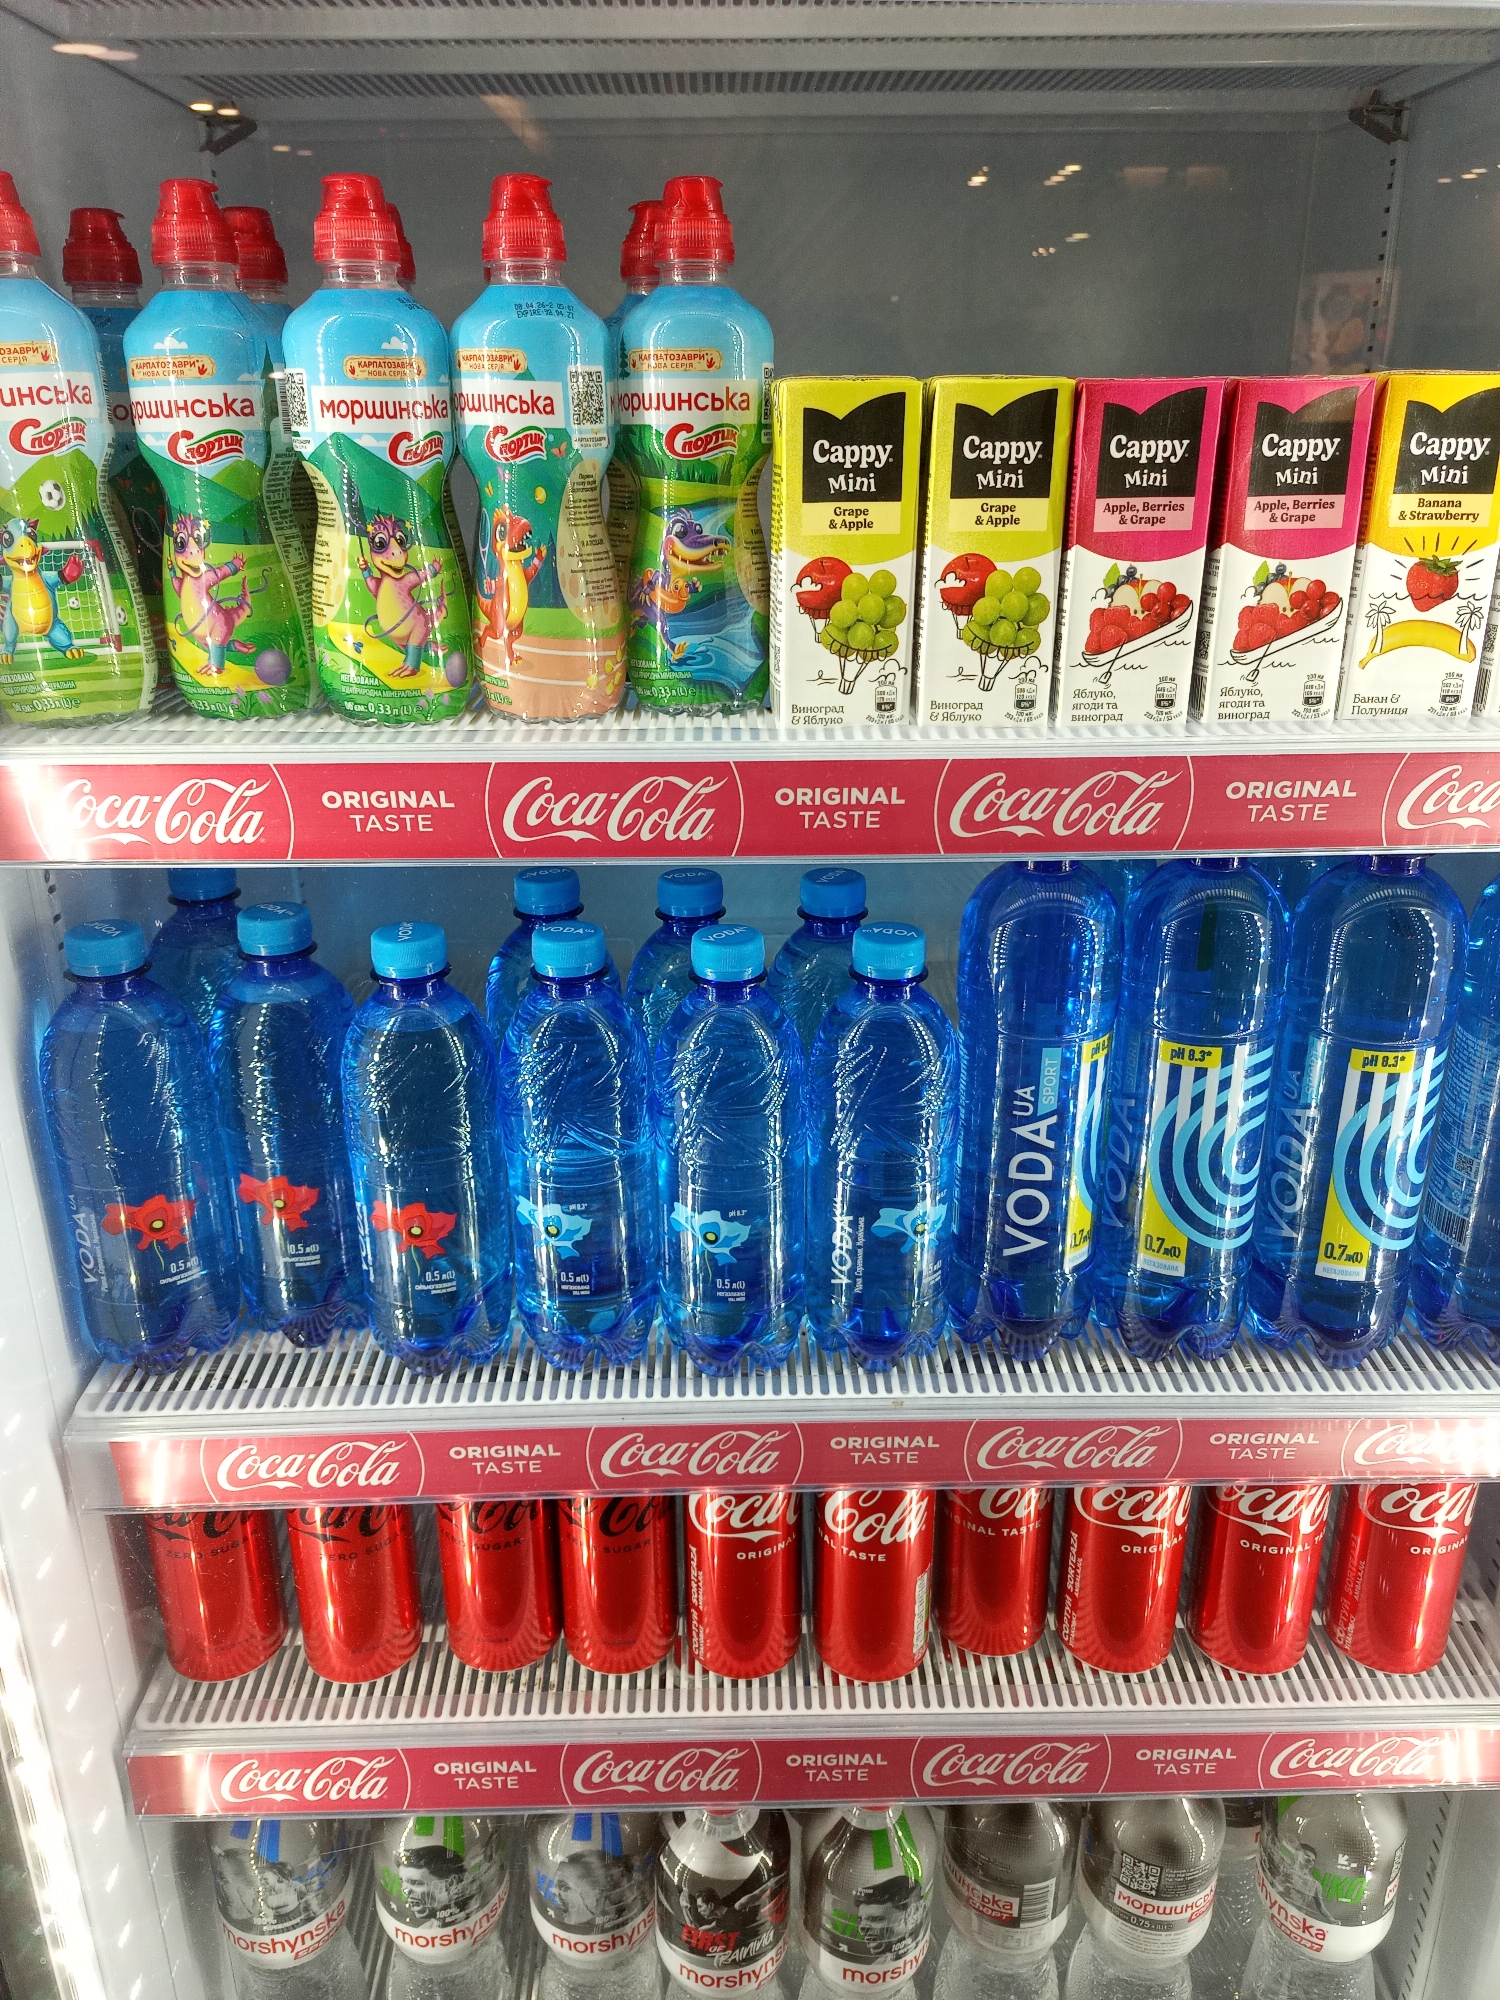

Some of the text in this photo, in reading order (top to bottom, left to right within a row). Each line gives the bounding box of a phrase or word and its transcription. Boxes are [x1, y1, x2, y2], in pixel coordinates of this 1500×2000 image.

[812, 439, 890, 468] Cappy
[962, 435, 1042, 465] Cappy
[1109, 434, 1190, 463] Cappy
[1261, 433, 1341, 462] Cappy
[1409, 431, 1491, 461] Cappy
[828, 472, 876, 493] Mini
[976, 470, 1024, 490] Mini
[1124, 469, 1168, 488] Mini
[1275, 466, 1319, 487] Mini
[1420, 465, 1469, 485] Mini
[980, 502, 1017, 515] Grape
[1103, 499, 1185, 515] Apple, Berries
[1254, 498, 1336, 513] Apple, Berries
[1417, 497, 1462, 509] Banana
[833, 506, 870, 519] Grape
[1119, 512, 1166, 526] & Grape
[1269, 511, 1316, 525] & Grape
[1398, 509, 1480, 522] & Strawberry
[828, 519, 874, 531] & Apple
[975, 515, 1021, 528] & Apple
[1073, 688, 1116, 700] Яблуко,
[1220, 686, 1263, 698] Яблуко,
[1352, 693, 1401, 704] Банан &
[368, 702, 392, 715] 0,33
[791, 703, 844, 716] Виноград
[930, 700, 983, 712] Виноград
[1071, 701, 1119, 713] ягоди та
[1218, 699, 1266, 711] ягоди та
[1350, 705, 1408, 717] Полуниця
[791, 714, 844, 726] & Яблуко
[930, 711, 982, 723] & Яблуко
[1071, 712, 1123, 723] виноград
[1217, 710, 1270, 721] виноград
[774, 787, 906, 806] ORIGINAL
[1225, 780, 1358, 799] ORIGINAL
[322, 790, 455, 810] ORIGINAL
[949, 769, 1183, 838] Coca-Cola
[55, 778, 271, 846] Coca-Cola
[502, 776, 729, 842] Coca-Cola
[1247, 804, 1329, 823] TASTE
[350, 814, 434, 833] TASTE
[799, 810, 881, 829] TASTE
[542, 926, 584, 934] VODA
[701, 927, 742, 942] VODA
[873, 928, 918, 938] VODA
[1169, 1047, 1185, 1062] pH
[1361, 1055, 1379, 1069] pH
[1002, 1057, 1058, 1257] VODA UA SPORT
[1264, 1107, 1317, 1239] VODA
[72, 1213, 98, 1283] VODA
[170, 1259, 185, 1273] 0.5
[425, 1270, 440, 1282] 0.5
[561, 1272, 574, 1282] 0.5
[716, 1279, 731, 1289] 0.5
[830, 1435, 940, 1449] ORIGINAL
[1209, 1431, 1320, 1446] ORIGINAL
[449, 1444, 561, 1459] ORIGINAL
[600, 1430, 791, 1478] Coca-Cola
[977, 1425, 1173, 1471] Coca-Cola
[1228, 1447, 1297, 1461] TASTE
[850, 1451, 919, 1465] TASTE
[216, 1440, 409, 1492] Coca-Cola
[471, 1460, 543, 1475] TASTE
[1001, 1518, 1042, 1537] TASTE
[474, 1537, 523, 1551] SUGAR
[603, 1538, 651, 1554] SUGAR
[736, 1531, 797, 1560] ORIGINAL
[1121, 1534, 1183, 1555] ORIGINAL
[1240, 1538, 1311, 1555] ORIGINAL
[841, 1545, 887, 1562] TASTE
[1062, 1594, 1073, 1642] СОРТУЙ
[1335, 1597, 1350, 1646] СОРТУЙ
[785, 1753, 887, 1767] ORIGINAL
[1135, 1747, 1236, 1761] ORIGINAL
[1269, 1736, 1453, 1779] Coca-Cola
[433, 1760, 537, 1775] ORIGINAL
[573, 1748, 750, 1794] Coca-Cola
[922, 1741, 1101, 1787] Coca-Cola
[1153, 1762, 1217, 1775] TASTE
[219, 1755, 397, 1803] Coca-Cola
[805, 1768, 868, 1782] TASTE
[454, 1776, 519, 1790] TASTE
[222, 1899, 346, 1955] morshynska
[1130, 1916, 1151, 1928] 0.75
[681, 1924, 741, 1952] FIRST
